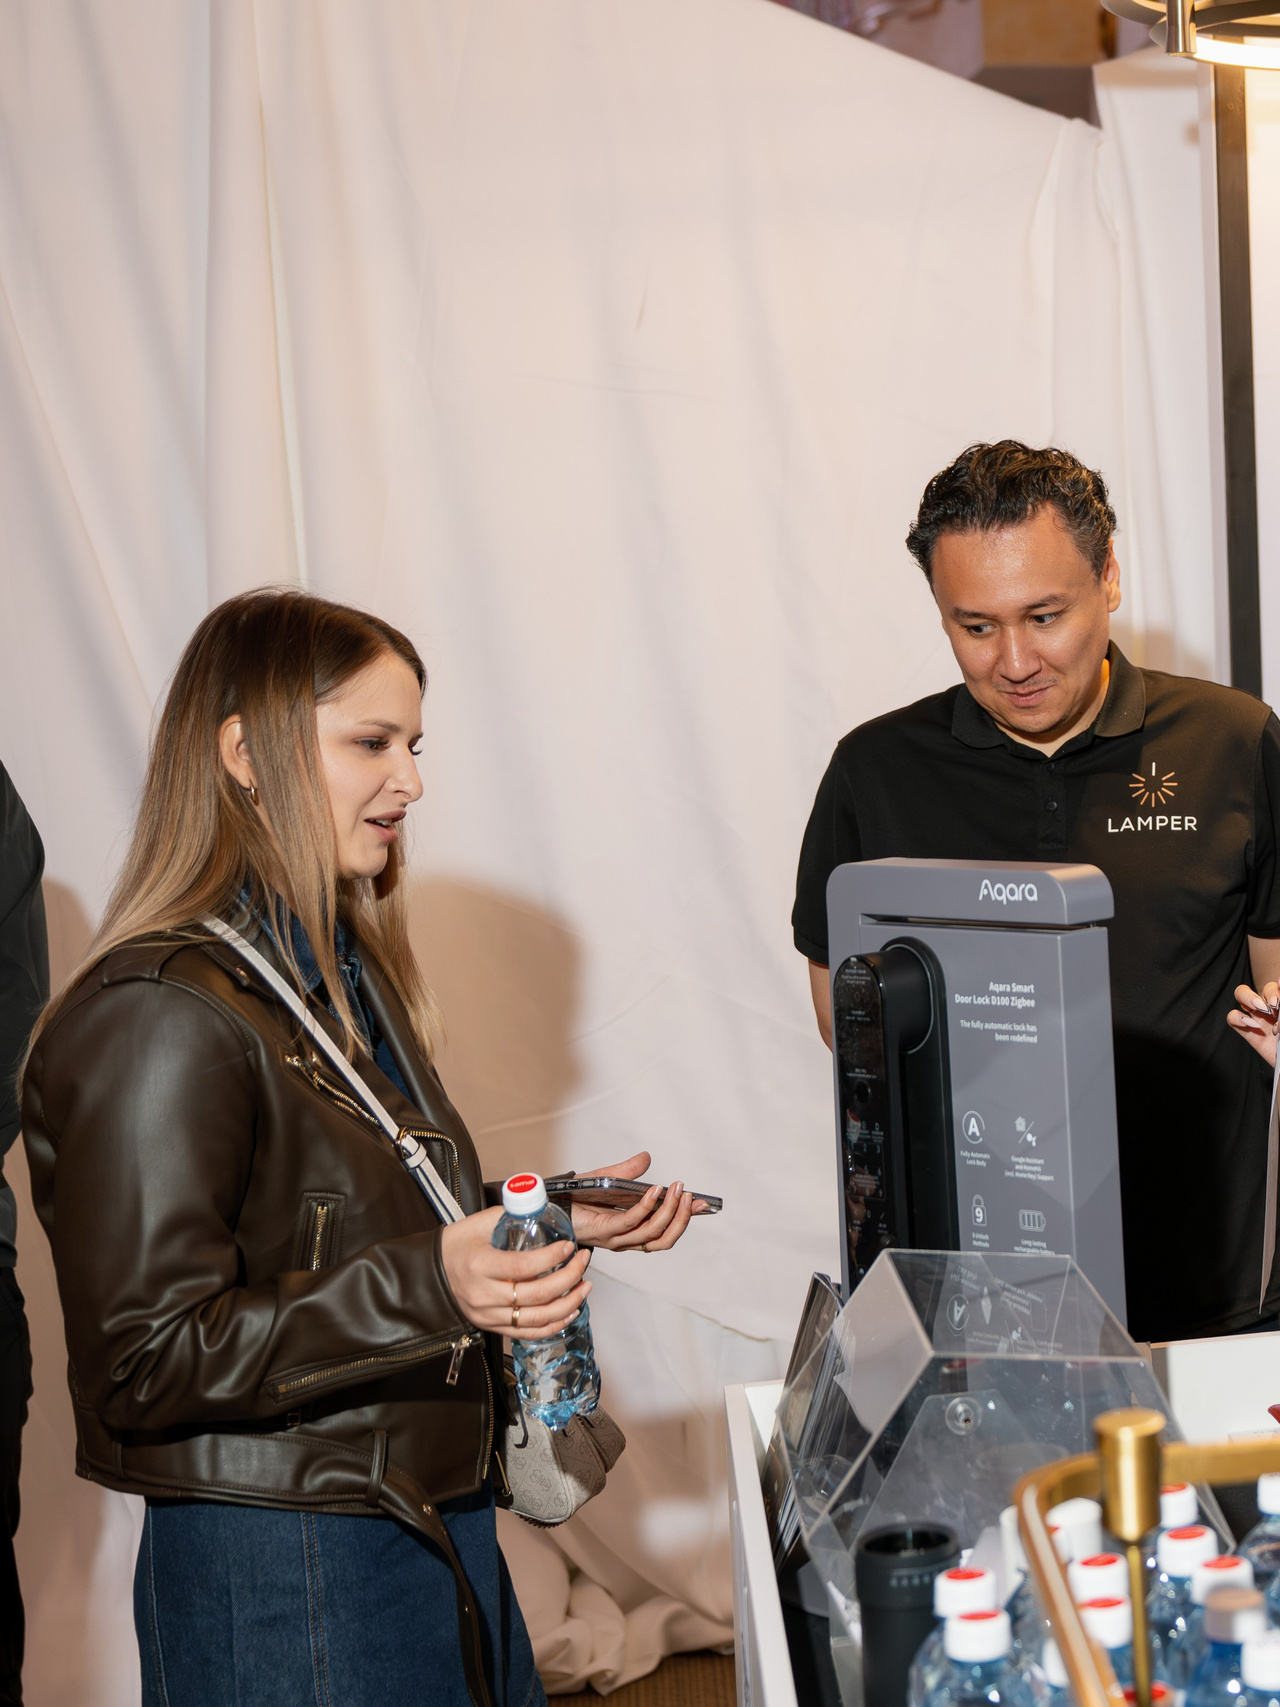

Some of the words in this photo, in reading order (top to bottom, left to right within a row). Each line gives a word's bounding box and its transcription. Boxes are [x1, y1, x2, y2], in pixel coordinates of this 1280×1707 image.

[1107, 815, 1198, 833] LAMPER
[978, 879, 1038, 905] Aqara
[989, 981, 1011, 993] Aqara
[1012, 982, 1035, 994] Smart
[954, 993, 972, 1004] Door
[973, 994, 990, 1005] Lock
[991, 995, 1009, 1006] D100
[1010, 996, 1036, 1009] Zigbee
[960, 1019, 971, 1028] The
[971, 1020, 984, 1030] fully
[984, 1021, 1013, 1031] automatic
[1013, 1022, 1026, 1031] lock
[1026, 1023, 1037, 1032] has
[995, 1032, 1009, 1041] been
[1010, 1034, 1038, 1043] redefined
[975, 1206, 983, 1223] 9
